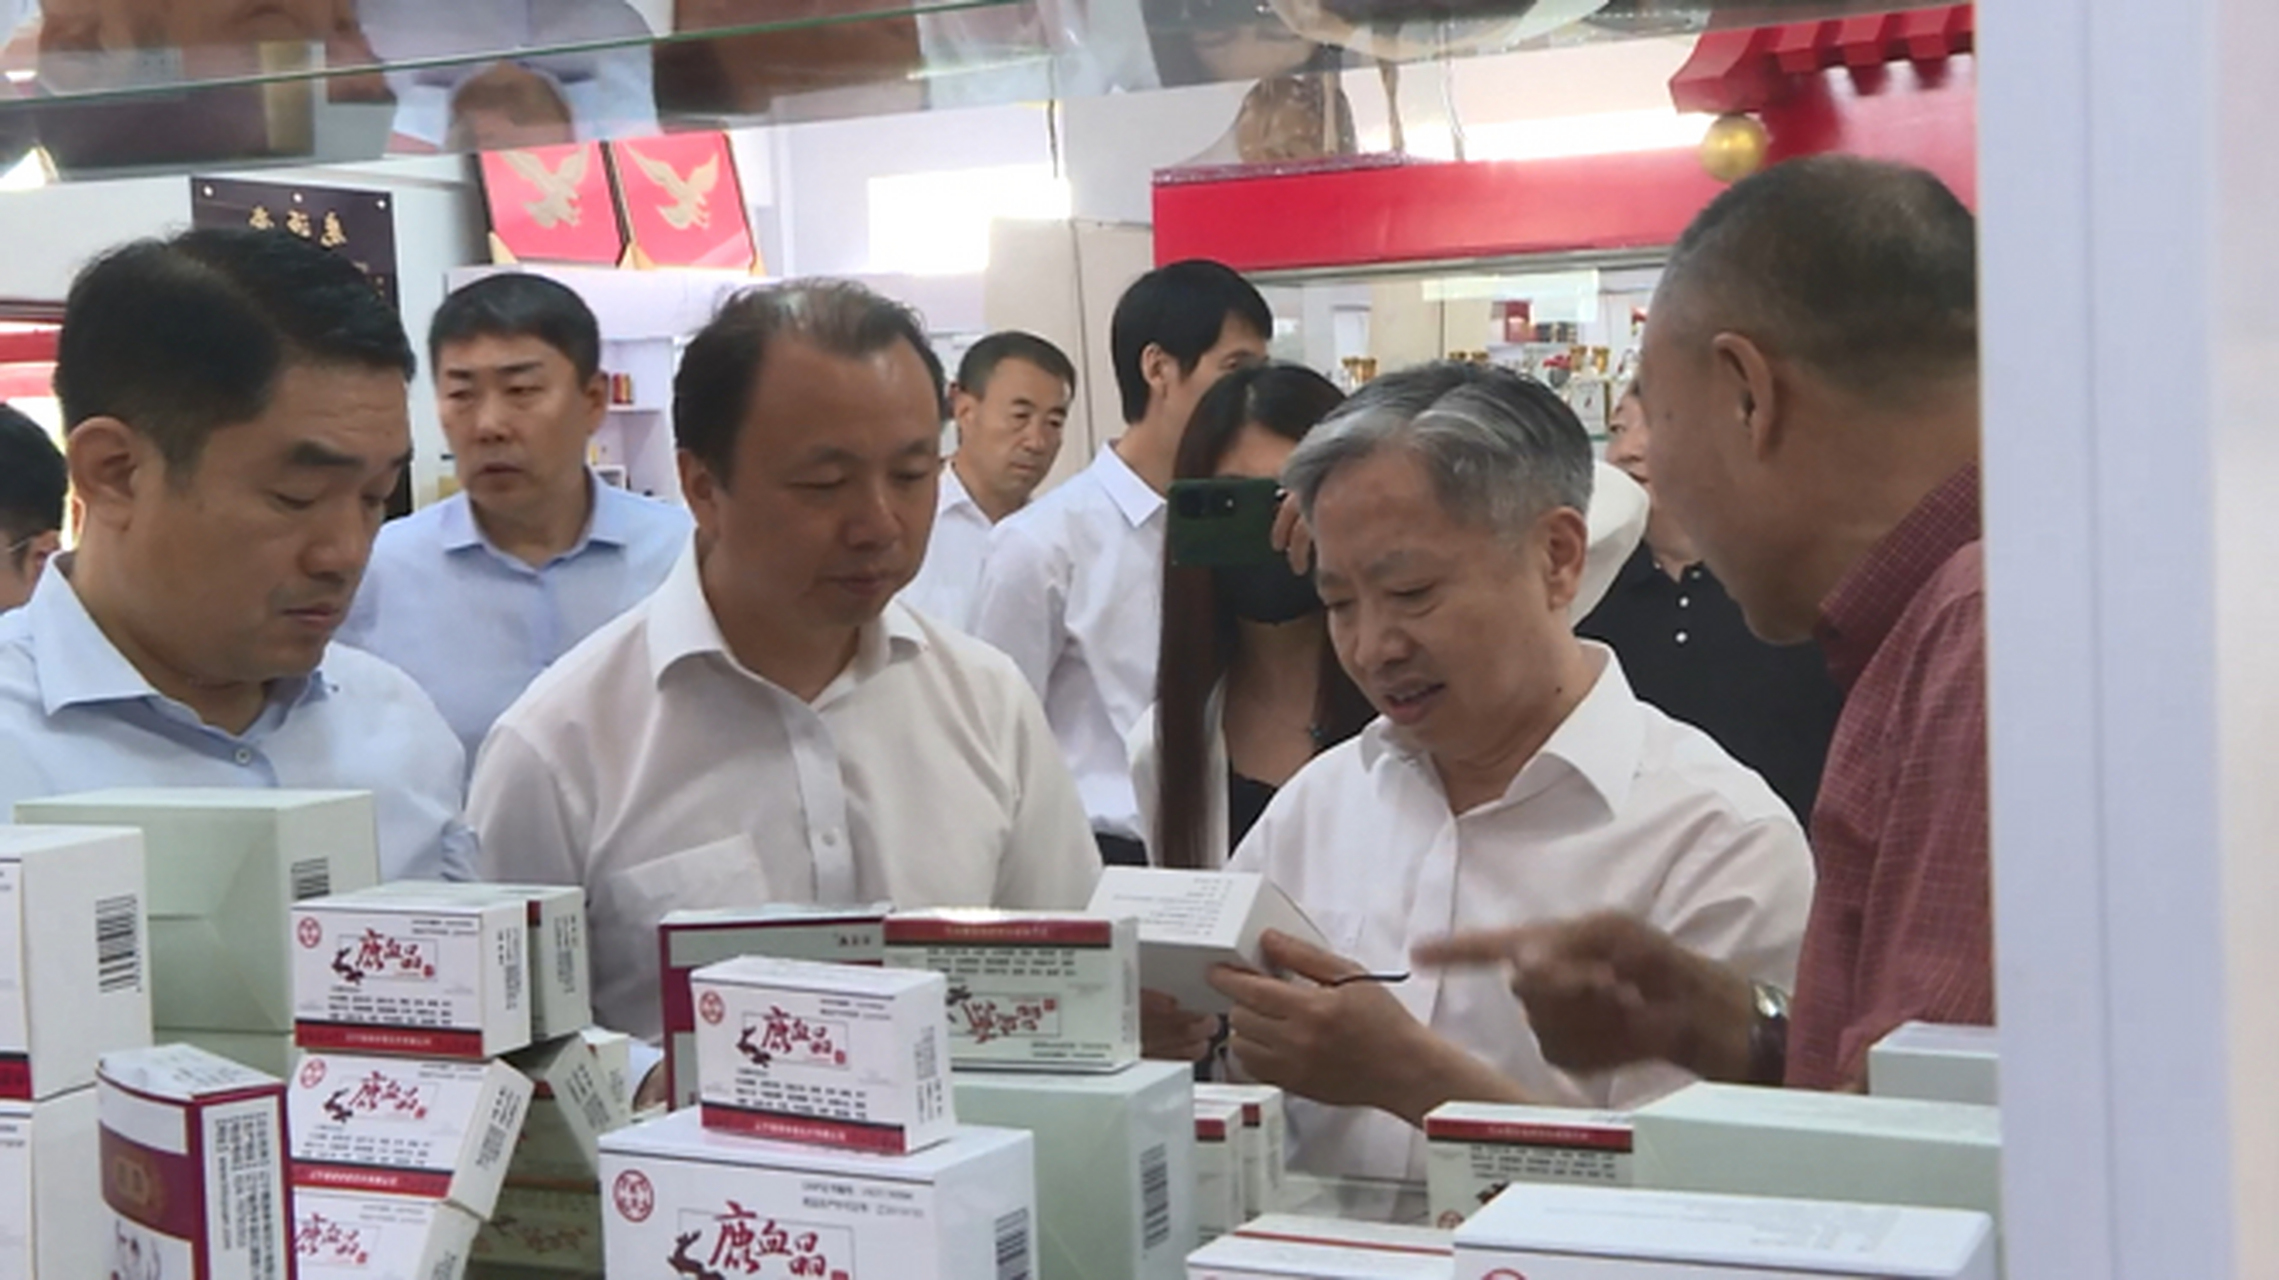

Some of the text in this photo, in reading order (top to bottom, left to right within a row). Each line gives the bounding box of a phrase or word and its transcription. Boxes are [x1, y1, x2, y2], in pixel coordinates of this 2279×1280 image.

[761, 1006, 833, 1054] 鹿血晶
[709, 1200, 826, 1277] 鹿血晶
